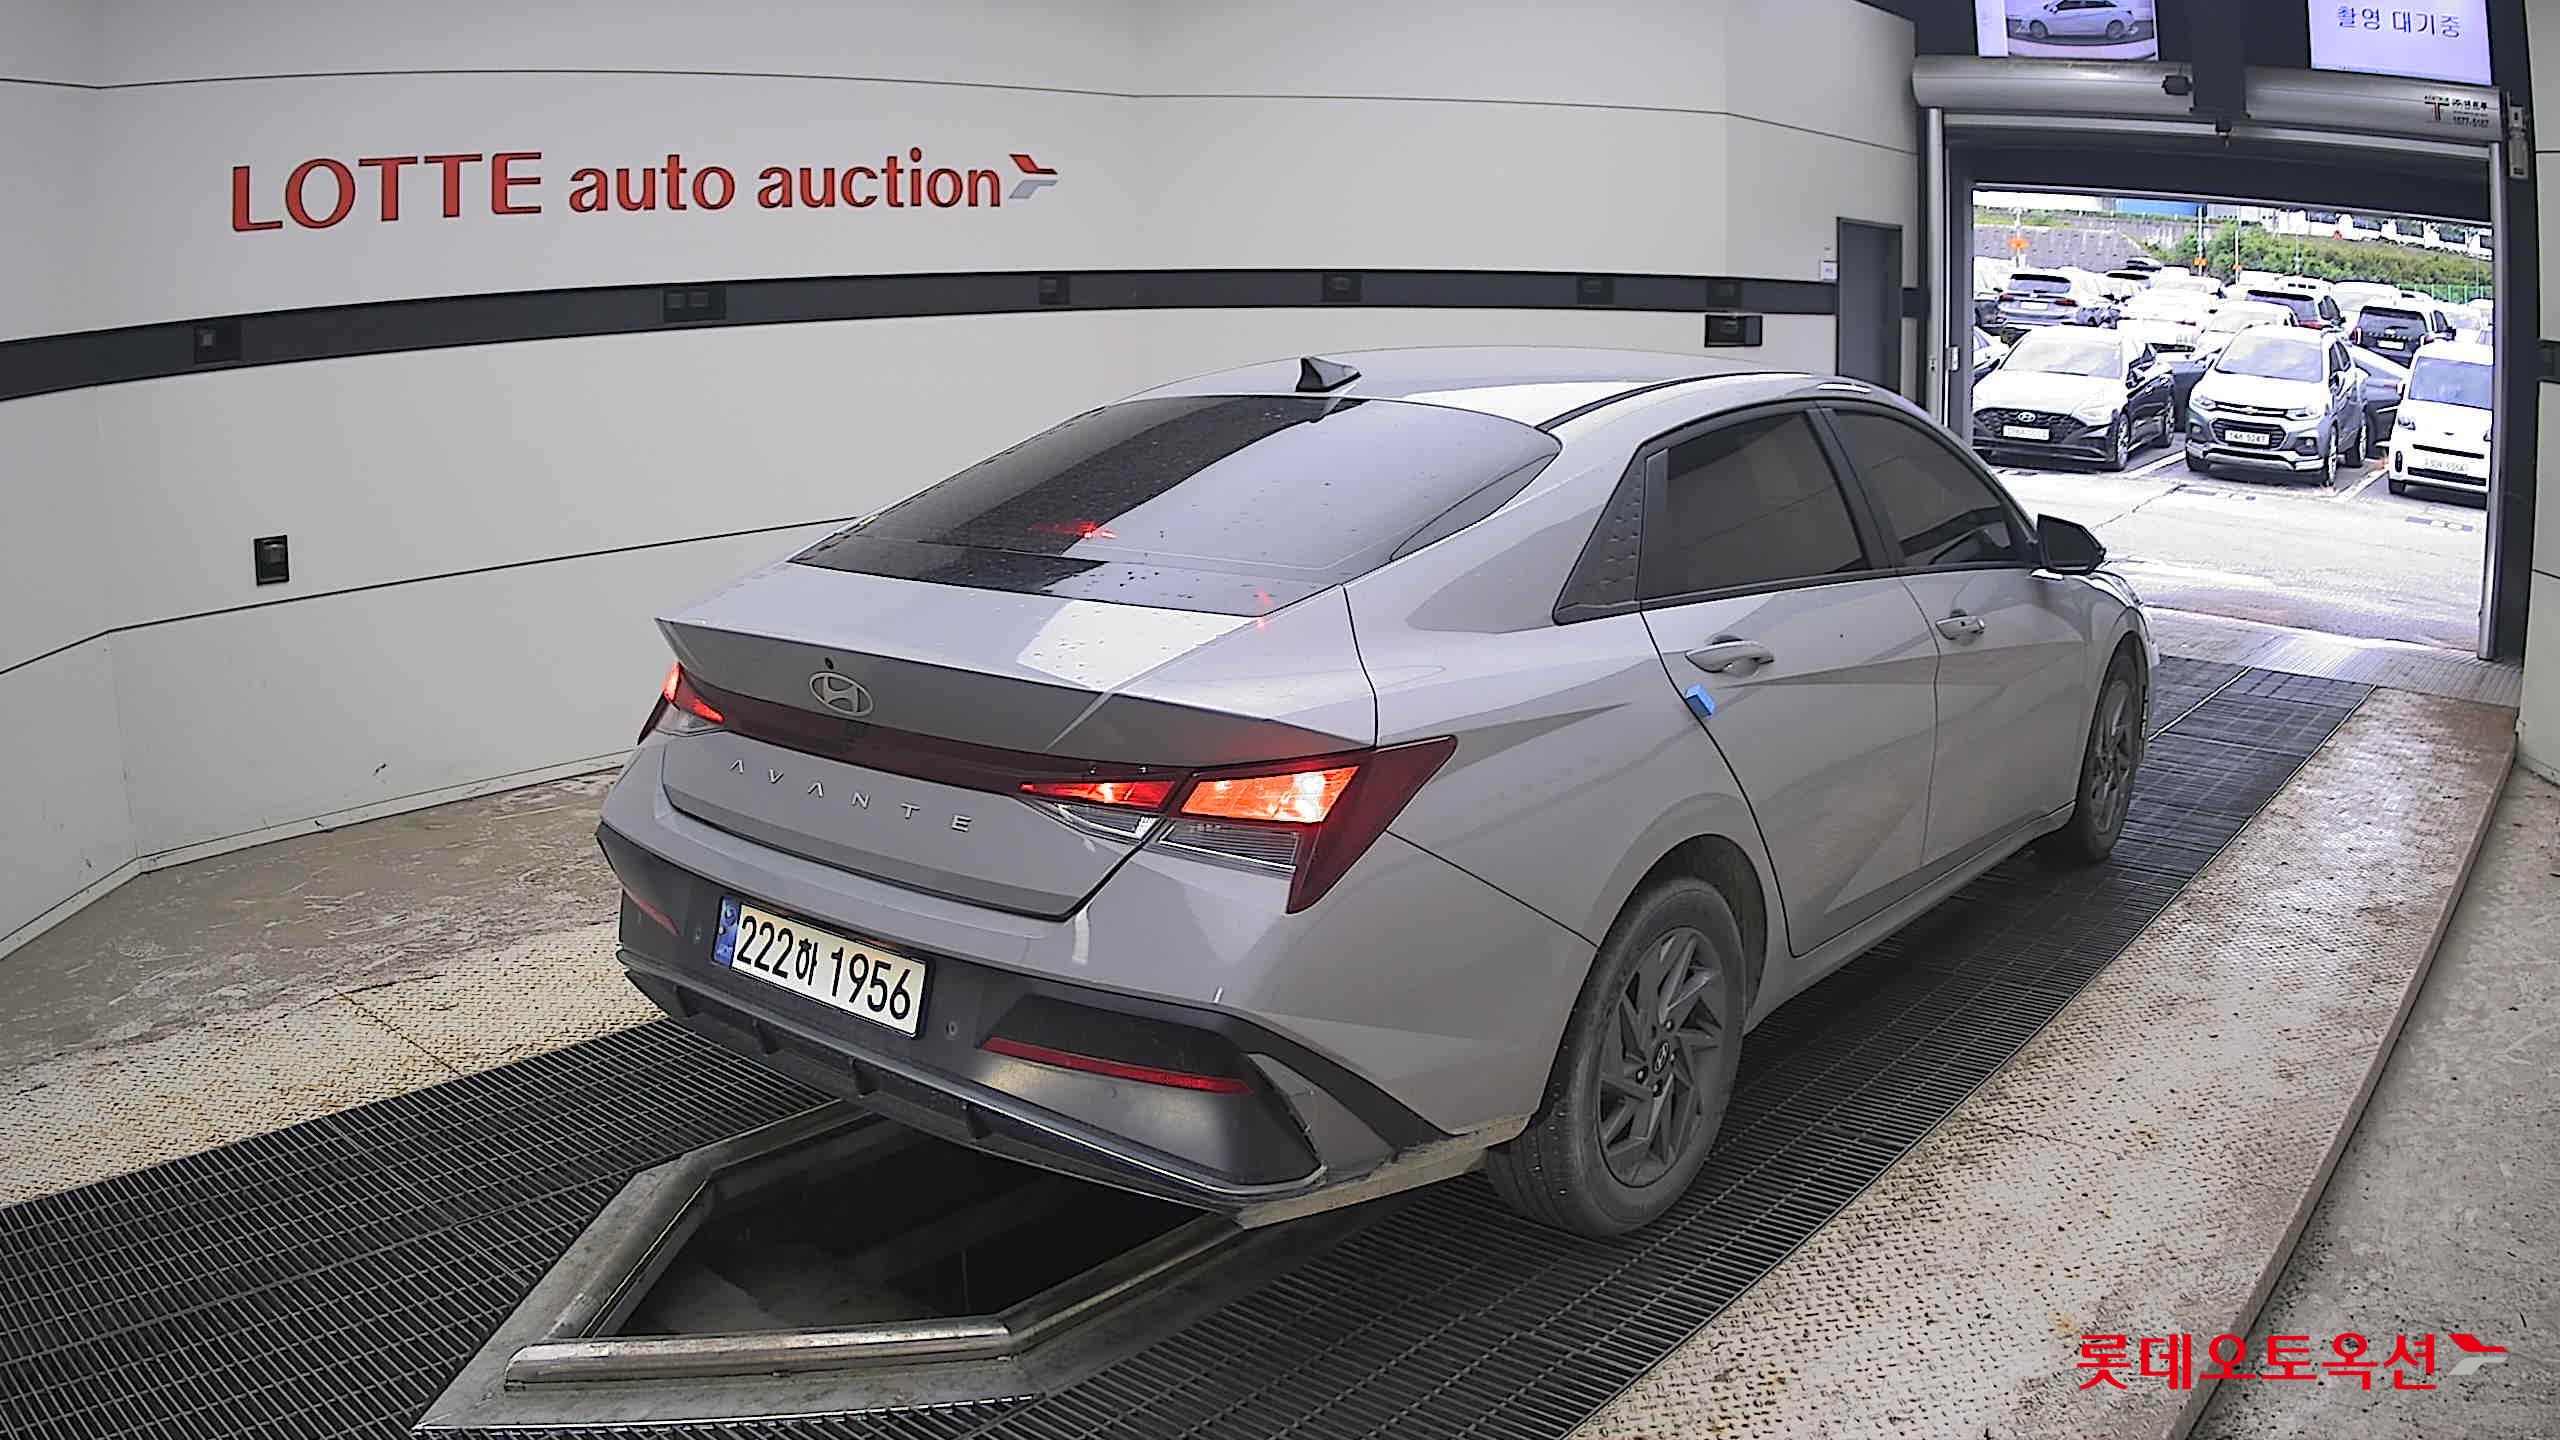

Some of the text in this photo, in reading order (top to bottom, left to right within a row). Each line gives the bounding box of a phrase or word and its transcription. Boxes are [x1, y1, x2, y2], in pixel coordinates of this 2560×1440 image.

[2338, 6, 2461, 39] 촬영 대기중
[232, 147, 1001, 232] LOTTE auto auction
[729, 758, 972, 833] AVANTE
[736, 915, 912, 1021] 222하 1956
